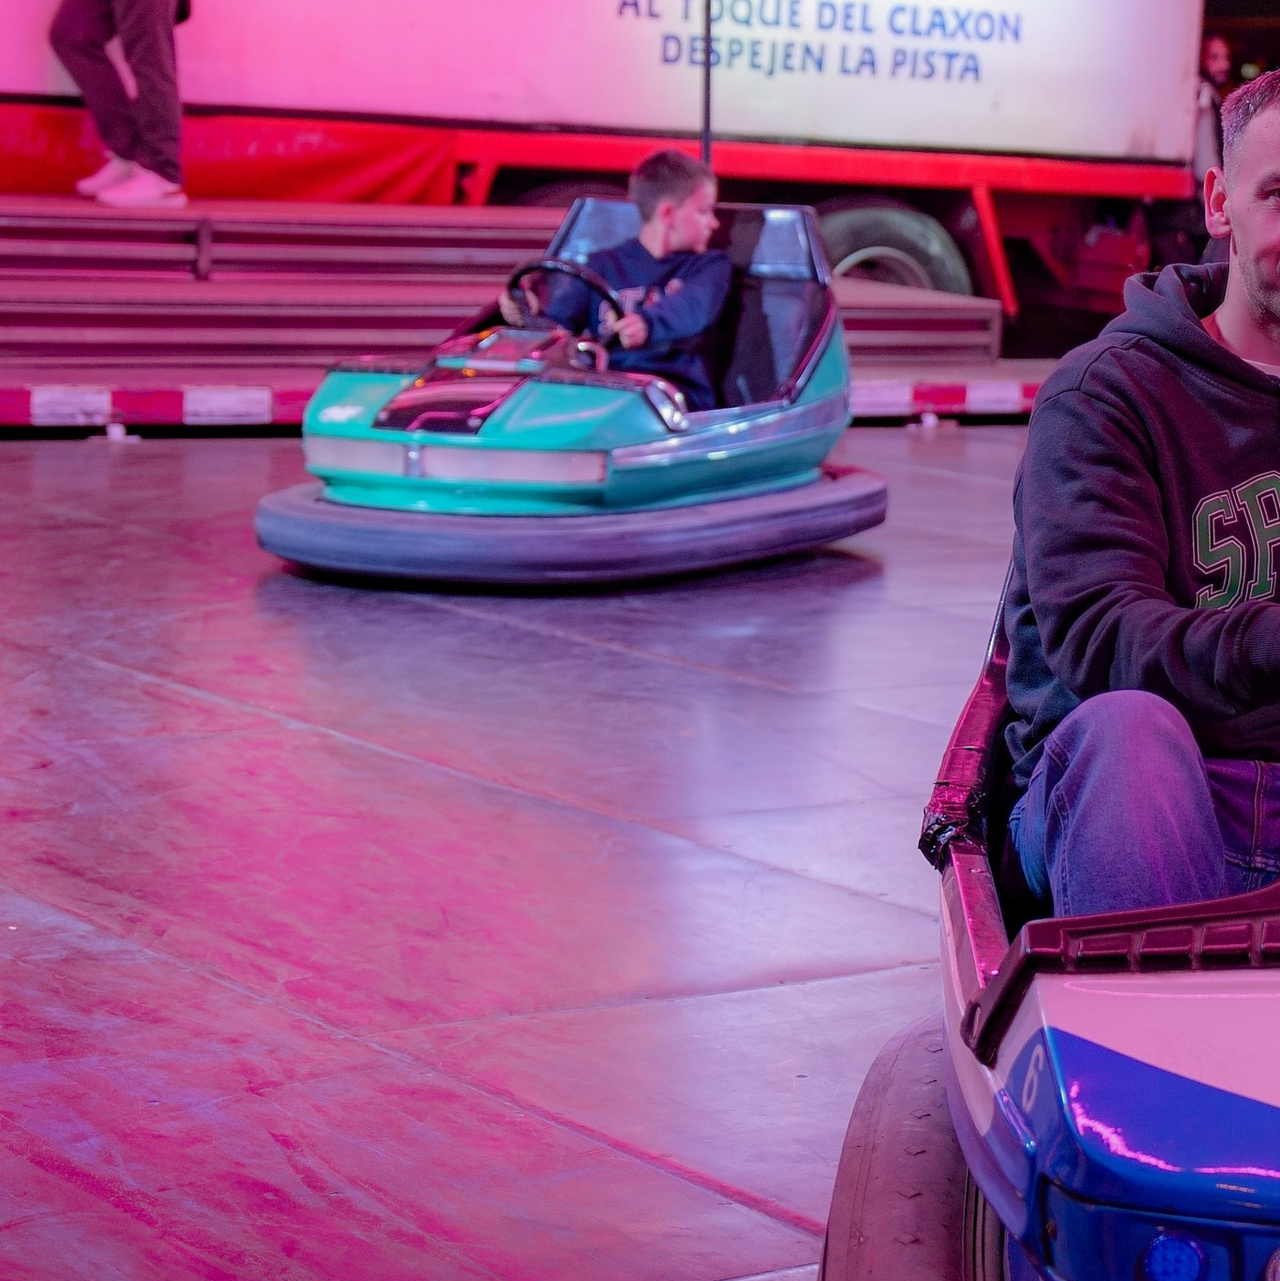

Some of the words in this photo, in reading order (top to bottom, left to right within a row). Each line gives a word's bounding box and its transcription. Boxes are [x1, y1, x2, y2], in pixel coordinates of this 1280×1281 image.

[817, 0, 875, 35] DEL
[887, 5, 1022, 43] CLAXON
[661, 34, 825, 77] DESPEJEN
[838, 45, 877, 76] LA
[890, 49, 982, 82] PISTA
